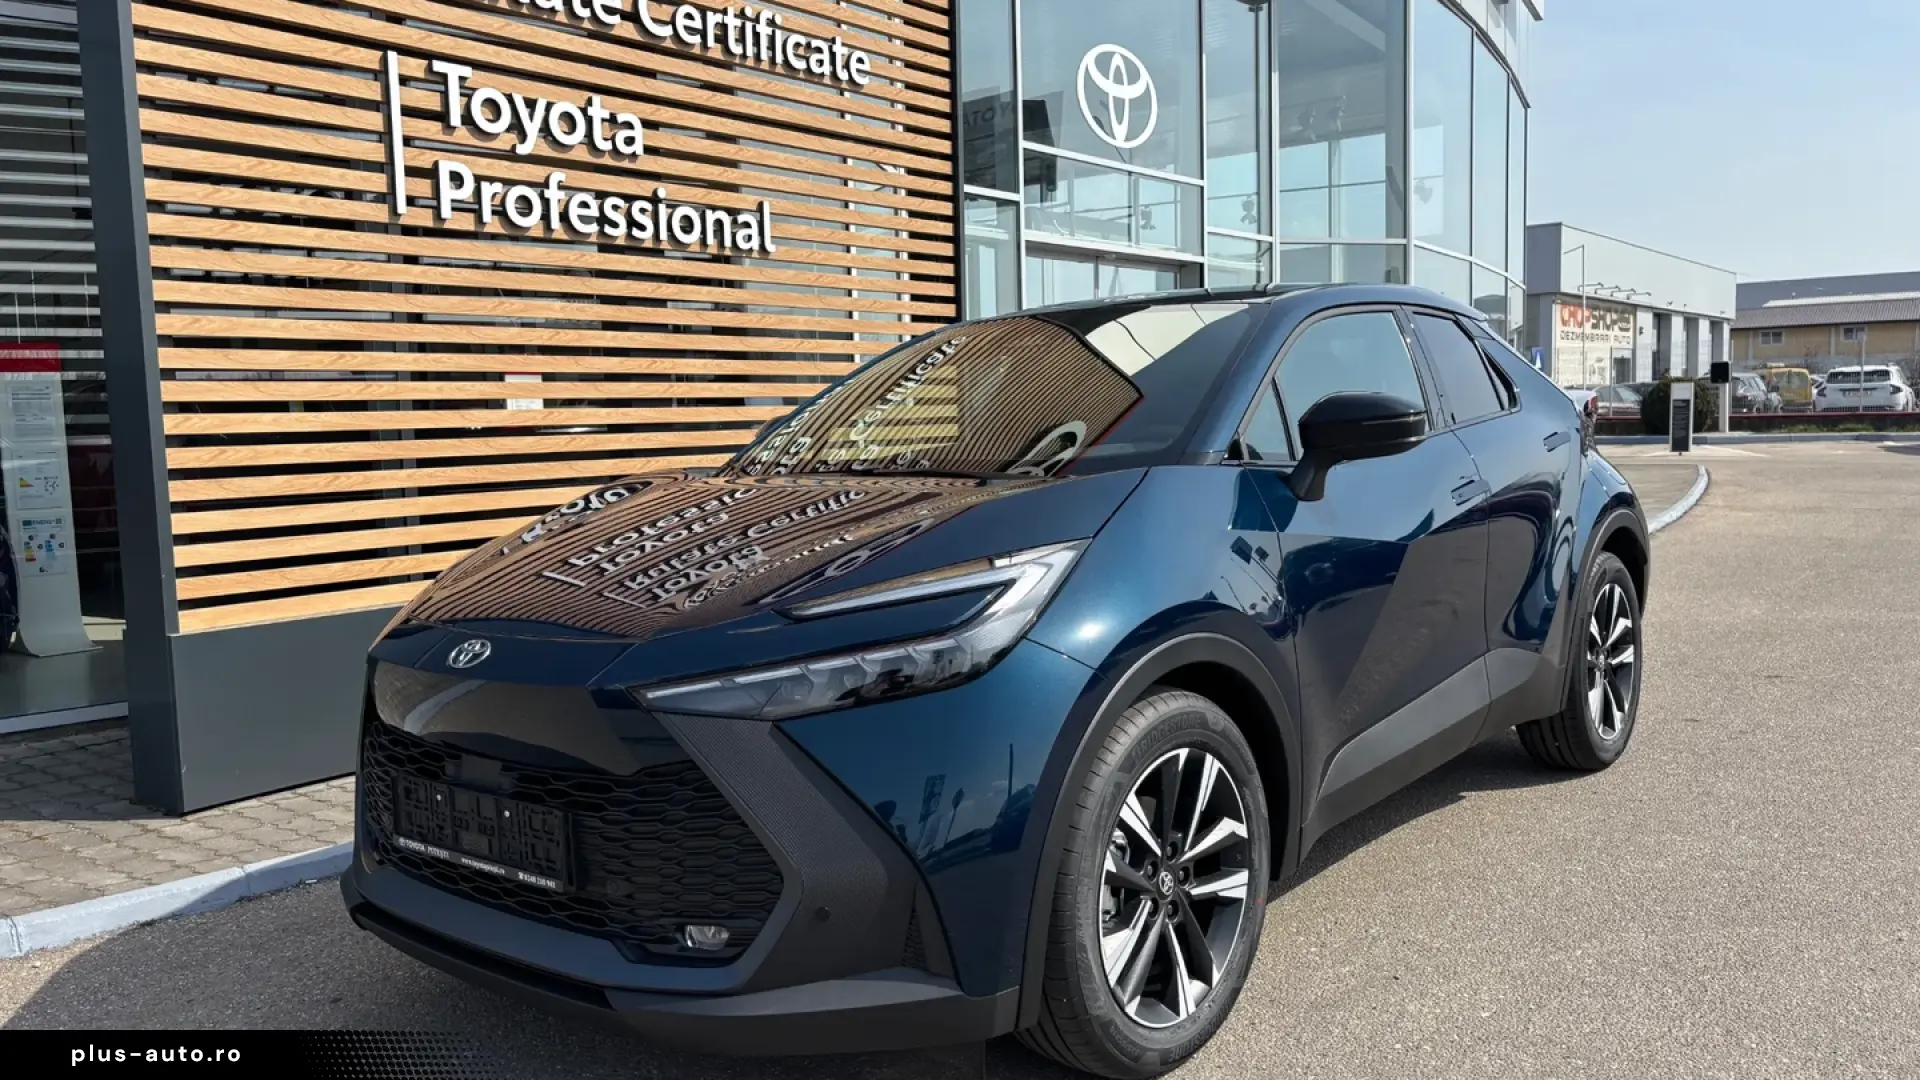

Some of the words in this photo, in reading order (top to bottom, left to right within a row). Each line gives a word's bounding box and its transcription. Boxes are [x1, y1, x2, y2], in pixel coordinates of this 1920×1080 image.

[637, 0, 871, 85] Certificate
[431, 60, 644, 155] Toyota
[437, 160, 776, 252] Professional
